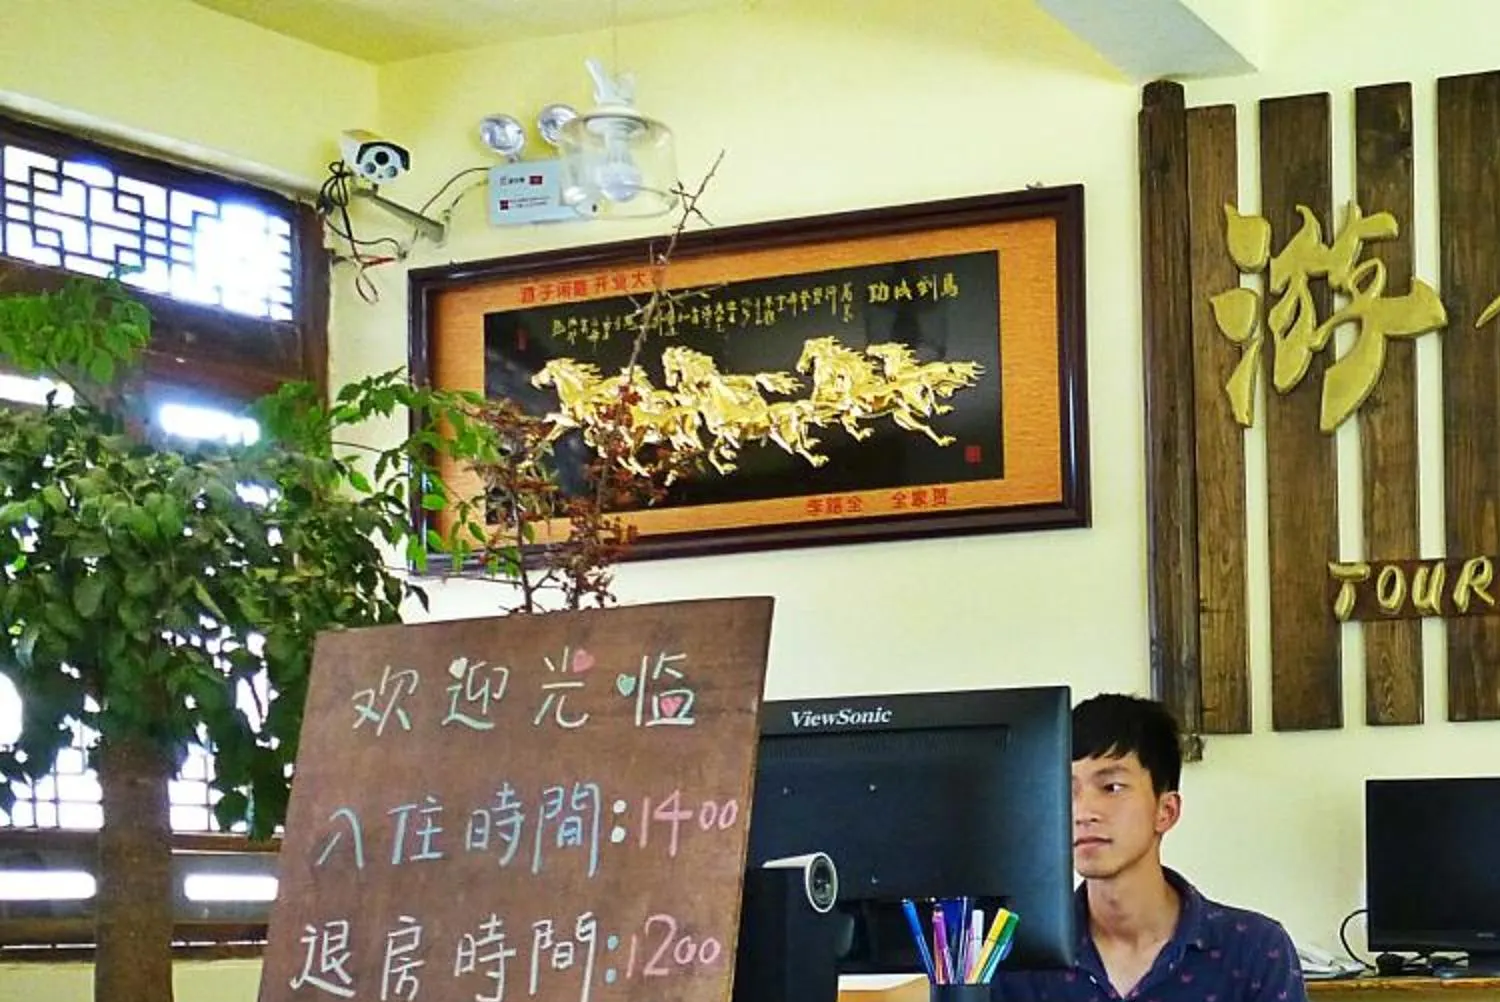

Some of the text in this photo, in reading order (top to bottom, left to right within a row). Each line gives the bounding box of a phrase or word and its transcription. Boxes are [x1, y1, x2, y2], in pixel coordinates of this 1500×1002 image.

[352, 645, 696, 738] 欢迎光临
[791, 706, 893, 728] ViewSonic
